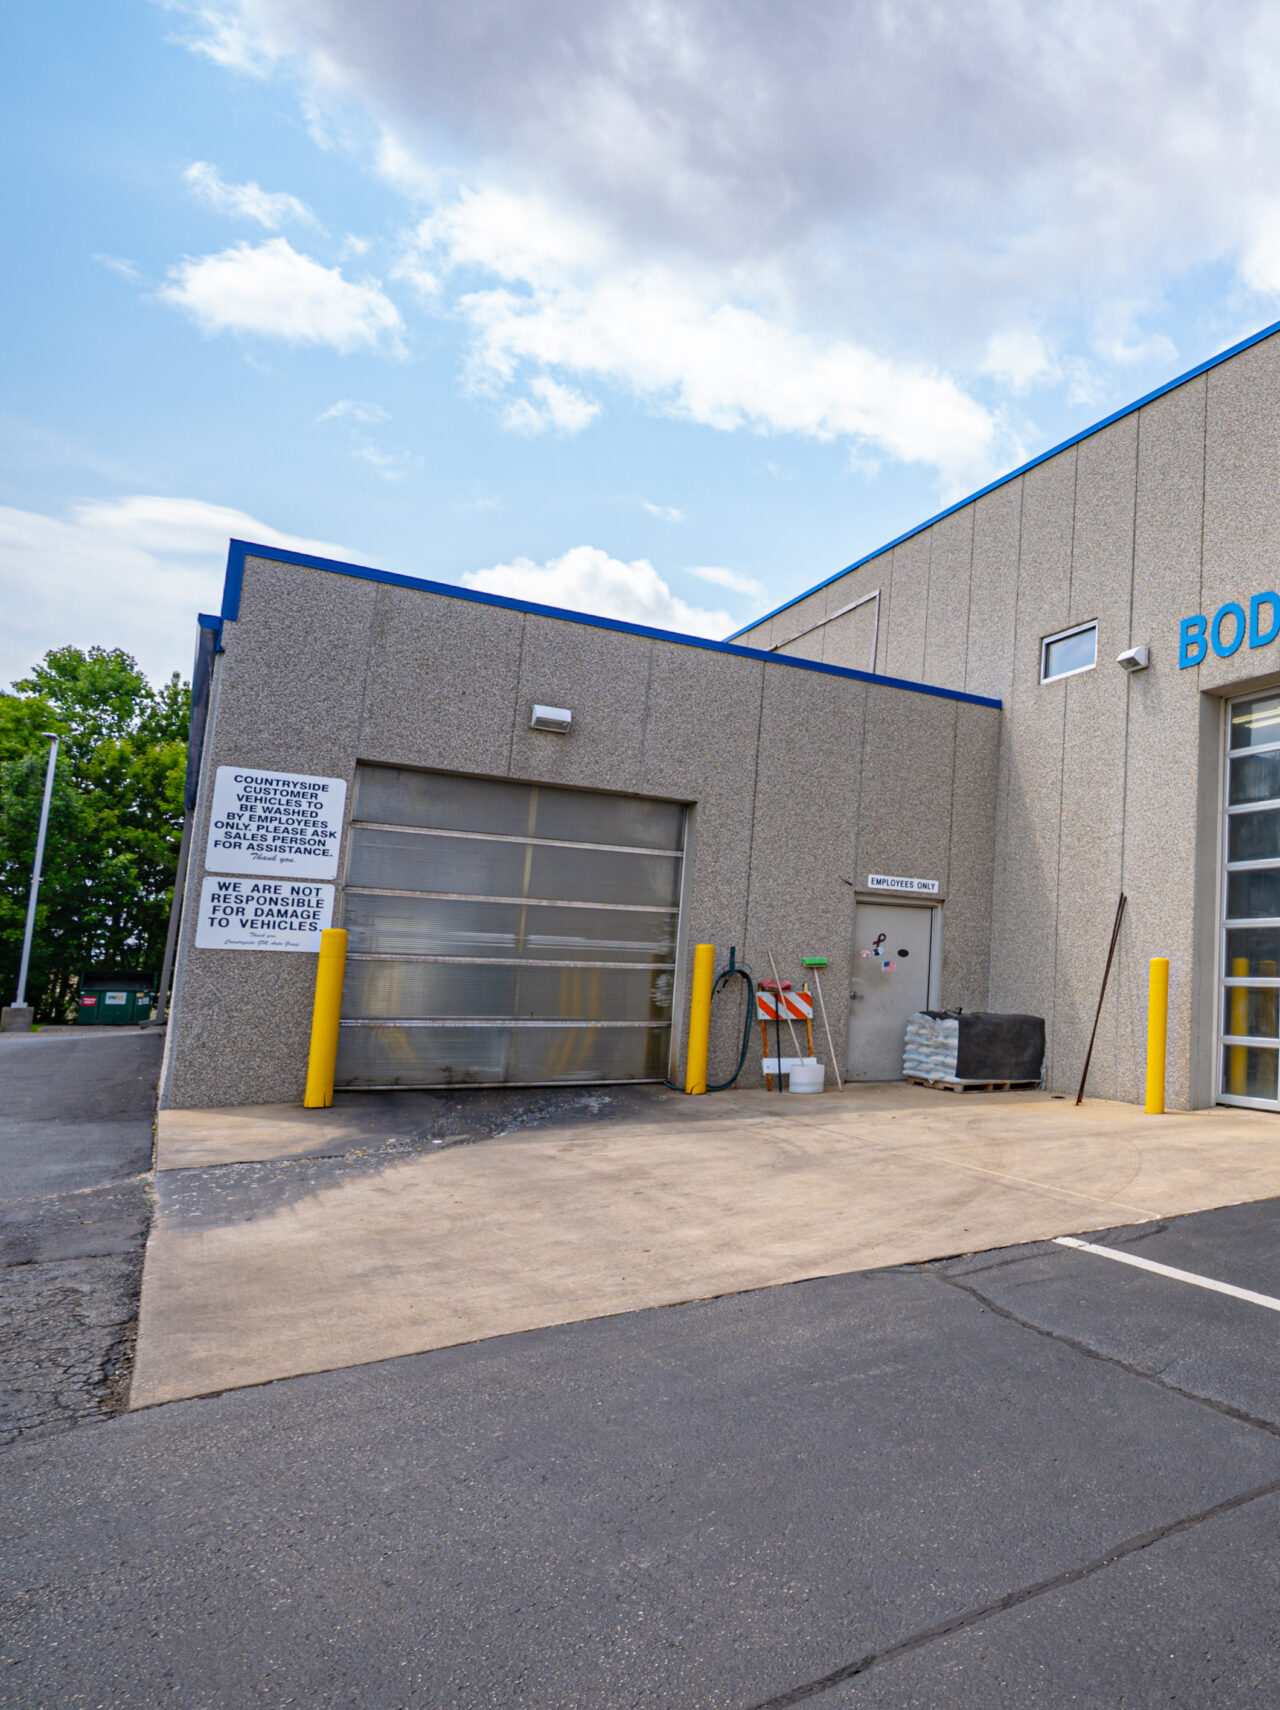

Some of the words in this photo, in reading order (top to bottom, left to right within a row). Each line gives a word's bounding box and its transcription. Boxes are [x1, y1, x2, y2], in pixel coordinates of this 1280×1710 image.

[234, 775, 329, 792] COUNTRYSIDE
[243, 786, 318, 800] CUSTOMER
[237, 794, 302, 808] VEHICLES
[307, 801, 323, 810] TO
[239, 804, 258, 813] BE
[262, 806, 318, 819] WASHED
[227, 812, 244, 821] BY
[249, 814, 328, 829] EMPLOYEES
[214, 821, 252, 832] ONLY.
[257, 824, 307, 836] PLEASE
[311, 830, 337, 839] ASK
[224, 831, 268, 842] SALES
[272, 835, 326, 847] PERSON
[213, 840, 242, 850] FOR
[246, 843, 333, 857] ASSISTANCE.
[250, 852, 277, 862] Thank
[217, 881, 242, 893] WE
[251, 884, 283, 895] ARE
[290, 886, 322, 897] NOT
[871, 877, 914, 889] EMPLOYEES
[917, 882, 936, 891] ONLY
[210, 893, 325, 909] RESPONSIBLE
[212, 905, 245, 917] FOR
[254, 907, 321, 920] DAMAGE
[208, 917, 230, 928] TO
[240, 918, 323, 932] VEHICLES.
